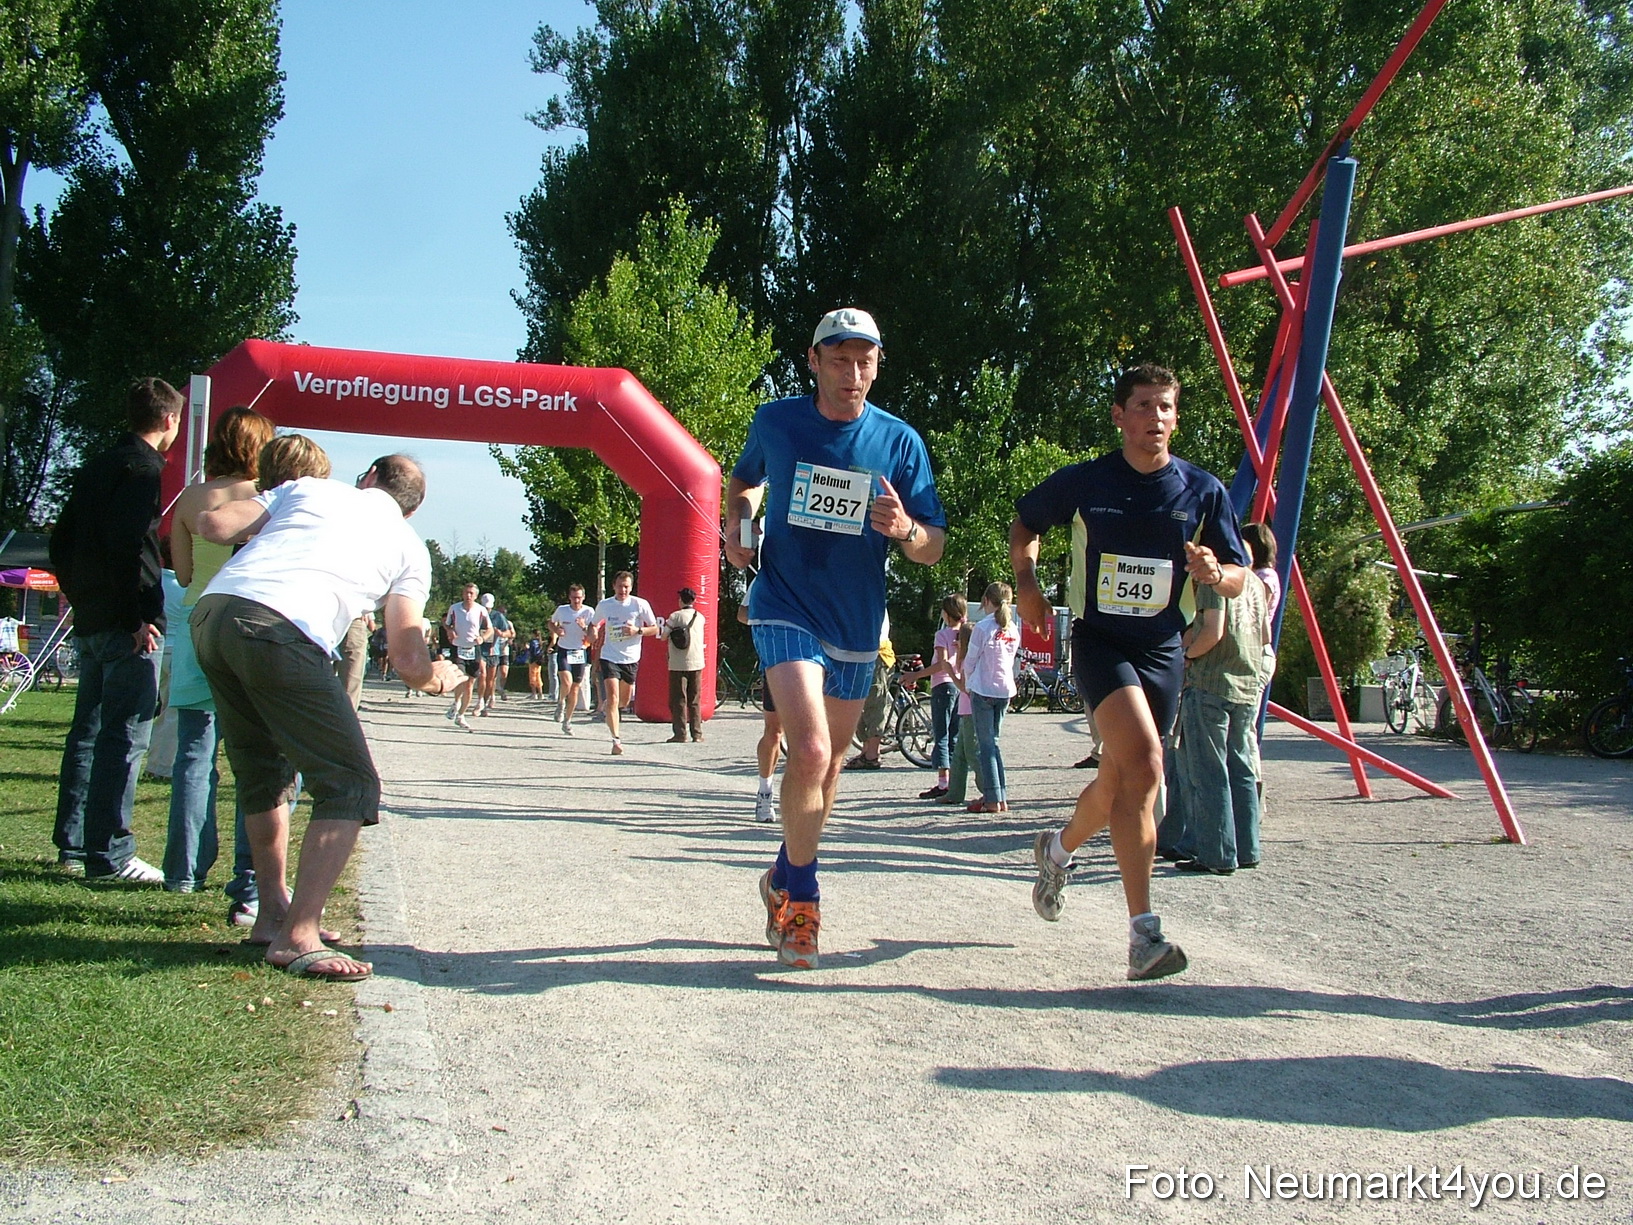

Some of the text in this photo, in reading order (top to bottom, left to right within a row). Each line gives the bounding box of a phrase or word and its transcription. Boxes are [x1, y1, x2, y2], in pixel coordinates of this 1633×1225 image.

[293, 370, 579, 412] Verpflegung LGS-Park
[812, 473, 850, 490] Helmut
[795, 487, 803, 497] A
[809, 494, 862, 516] 2957
[1117, 562, 1155, 575] Markus
[1101, 576, 1152, 600] A 549
